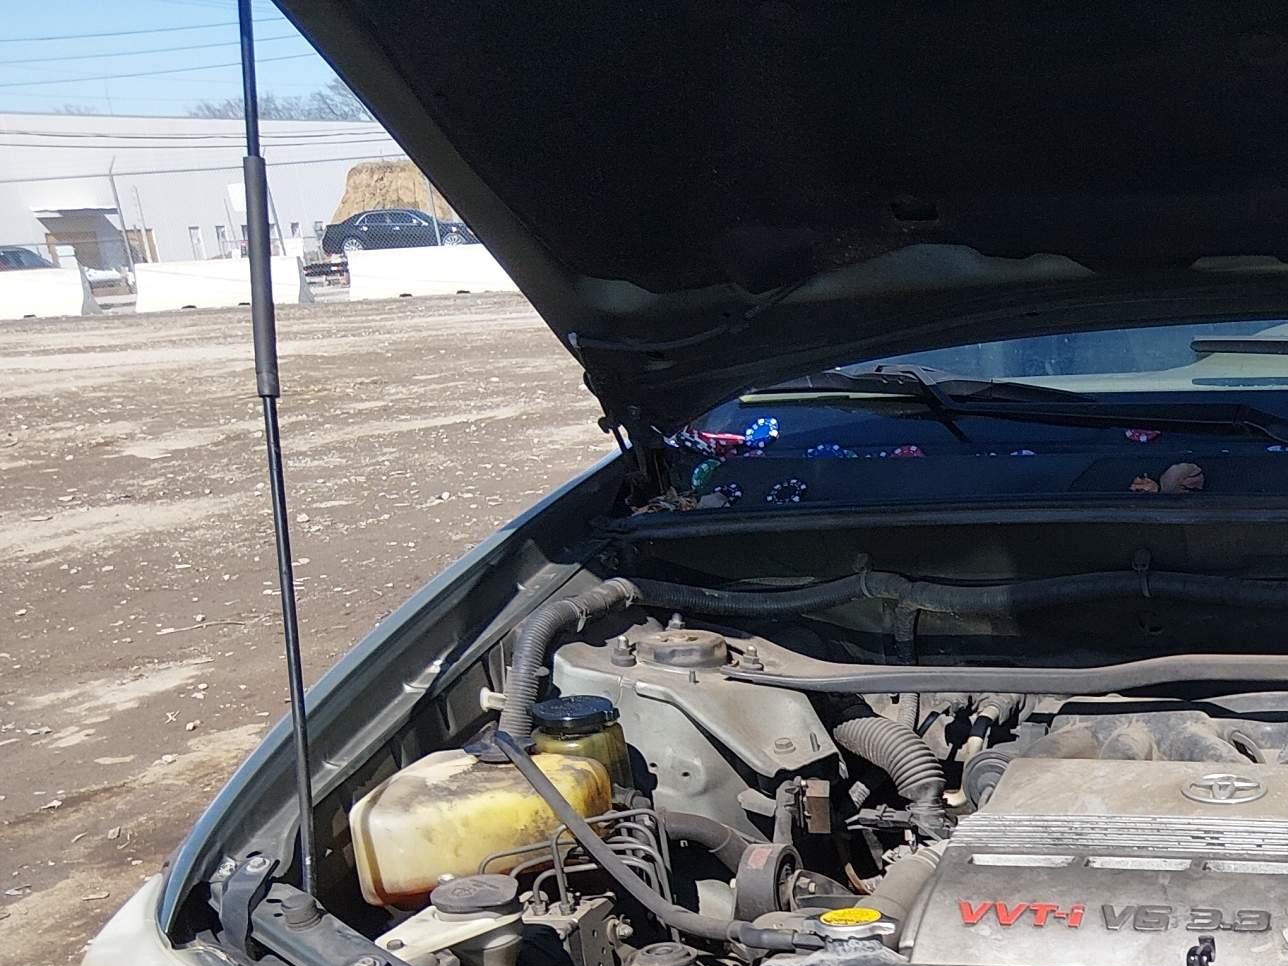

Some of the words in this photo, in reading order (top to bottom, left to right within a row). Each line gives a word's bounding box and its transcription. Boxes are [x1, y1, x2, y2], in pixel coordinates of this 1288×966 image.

[959, 900, 1086, 929] VVT-i
[1101, 904, 1173, 932] V6
[1186, 907, 1272, 933] 3.3
